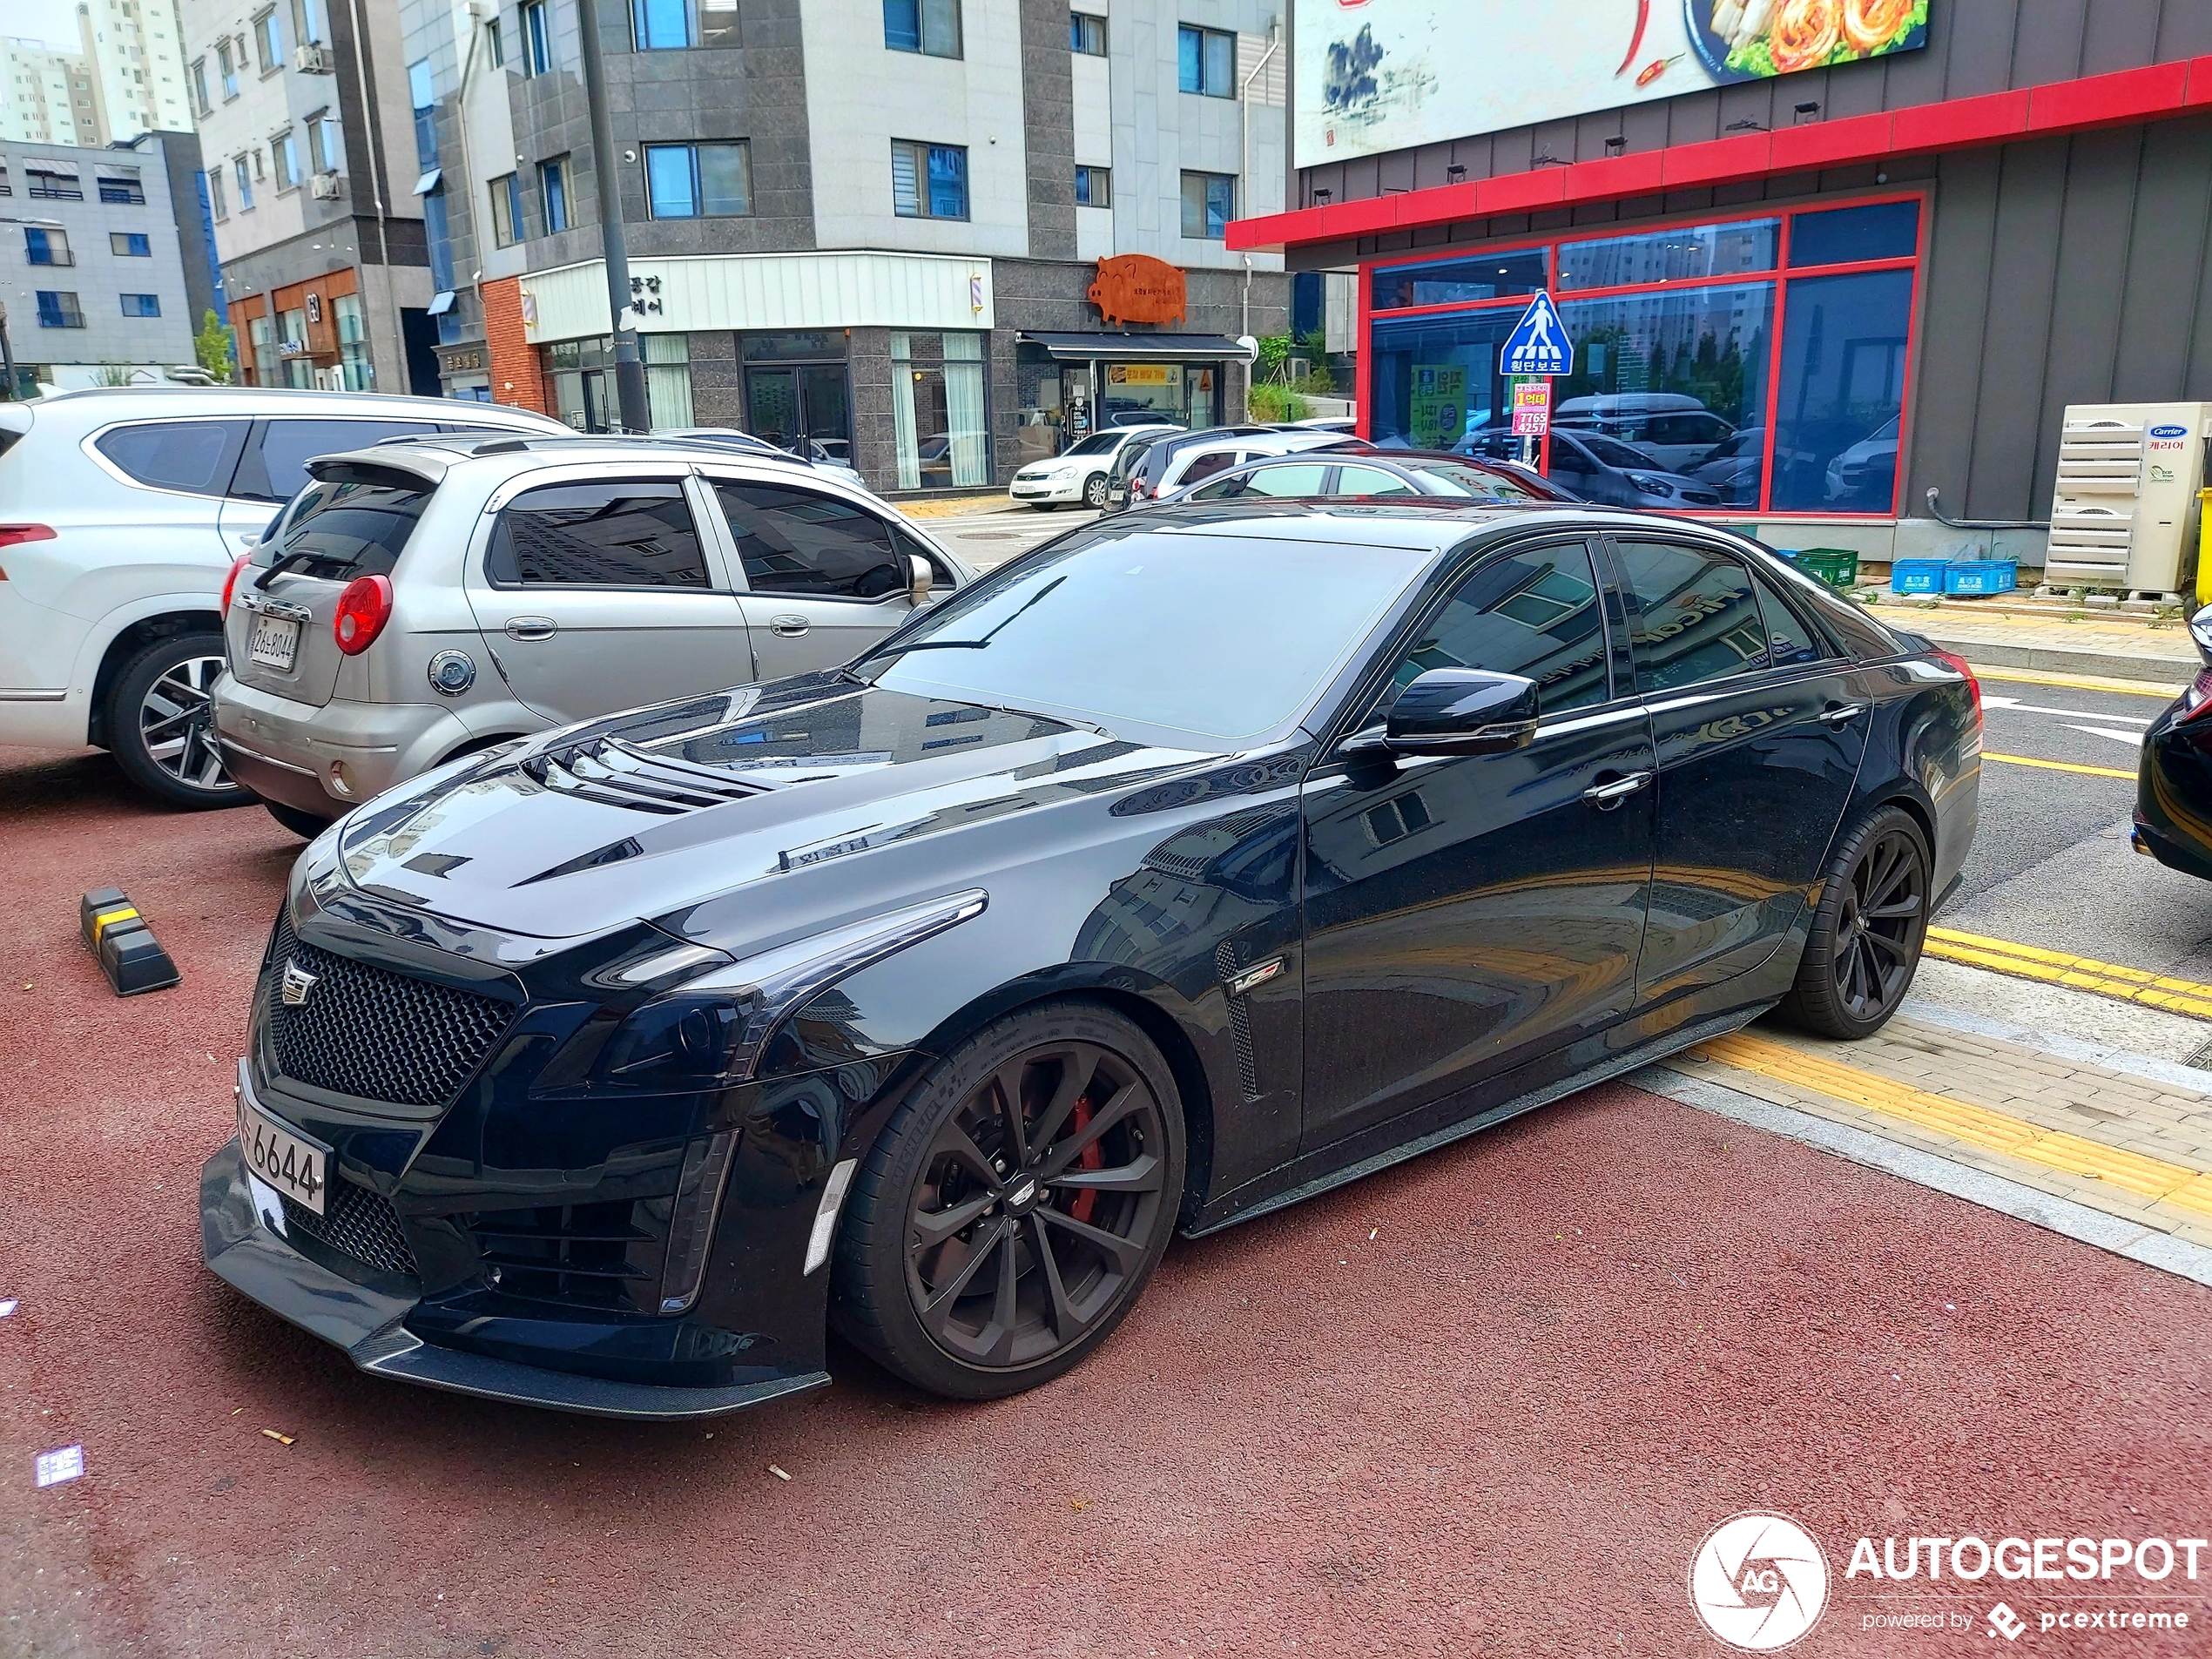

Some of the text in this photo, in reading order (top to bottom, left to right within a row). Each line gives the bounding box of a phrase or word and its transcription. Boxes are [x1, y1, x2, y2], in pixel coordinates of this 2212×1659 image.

[1510, 361, 1562, 372] 횡단보도
[1520, 413, 1546, 423] 7765
[1518, 423, 1546, 433] 4257
[2148, 441, 2184, 450] 캐리어
